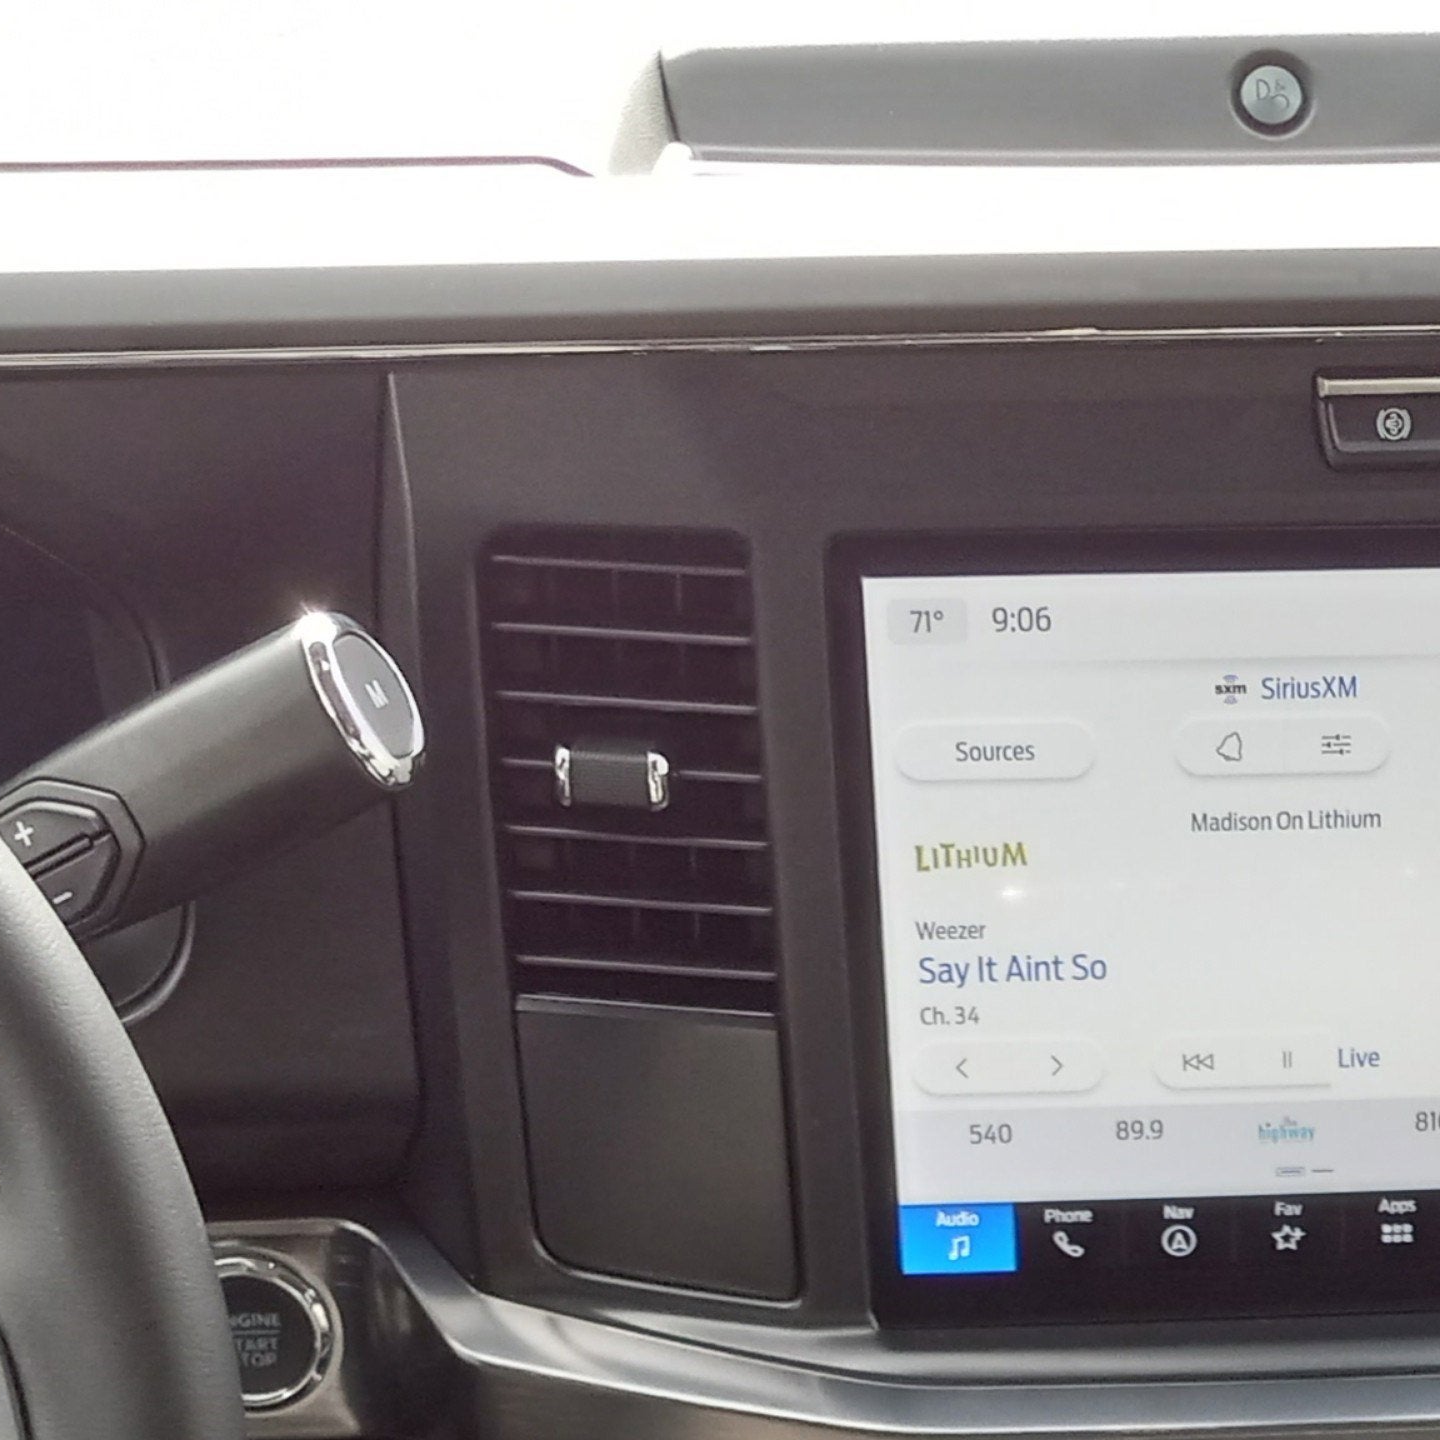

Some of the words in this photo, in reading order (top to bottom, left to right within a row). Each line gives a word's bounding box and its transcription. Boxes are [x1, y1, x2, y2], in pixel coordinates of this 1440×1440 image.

[991, 604, 1053, 634] 9:06
[365, 679, 390, 710] M
[1261, 674, 1358, 700] SiriusXM
[954, 740, 1036, 764] Sources
[1190, 808, 1272, 833] Madison
[1275, 810, 1304, 832] On
[1307, 807, 1383, 831] Lithium
[914, 921, 987, 942] Weezer
[917, 956, 968, 989] Say
[977, 955, 998, 984] It
[1004, 954, 1065, 983] Aint
[1071, 952, 1108, 981] So
[919, 1005, 951, 1026] Ch.
[953, 1005, 981, 1026] 34
[1337, 1048, 1381, 1070] Live
[968, 1123, 1014, 1145] 540
[1114, 1119, 1165, 1142] 89.9
[1043, 1208, 1094, 1225] Phone
[1163, 1204, 1195, 1220] Nav
[1274, 1201, 1303, 1217] Fav
[1378, 1197, 1417, 1215] Apps
[936, 1210, 980, 1228] Audio
[228, 1312, 281, 1328] NGINE
[236, 1336, 279, 1351] TART
[240, 1352, 279, 1368] TOP
